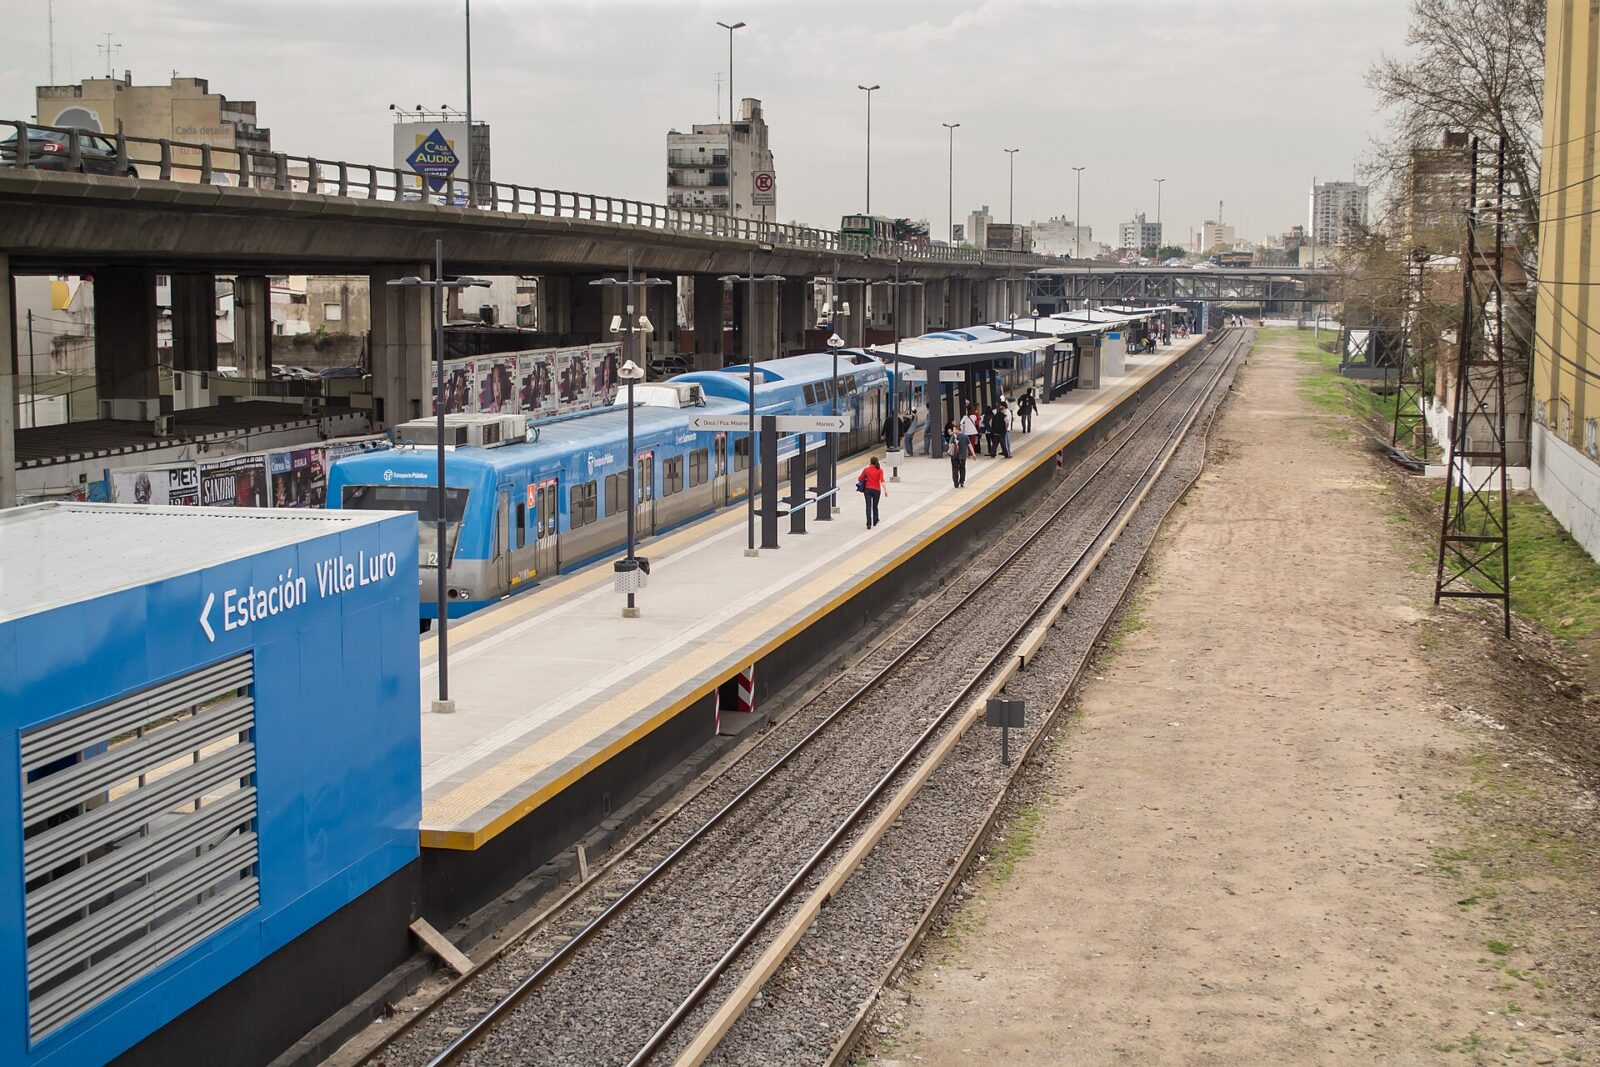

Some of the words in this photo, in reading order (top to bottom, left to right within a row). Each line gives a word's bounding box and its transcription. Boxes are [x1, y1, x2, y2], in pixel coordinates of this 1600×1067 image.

[175, 126, 197, 135] Cada
[200, 126, 230, 135] detalle
[424, 141, 448, 153] CASA
[415, 153, 455, 164] AUDIO
[204, 475, 236, 504] SANDRO
[429, 553, 438, 565] 2
[224, 568, 307, 631] Estación
[315, 555, 355, 598] Villa
[358, 550, 396, 586] Luro
